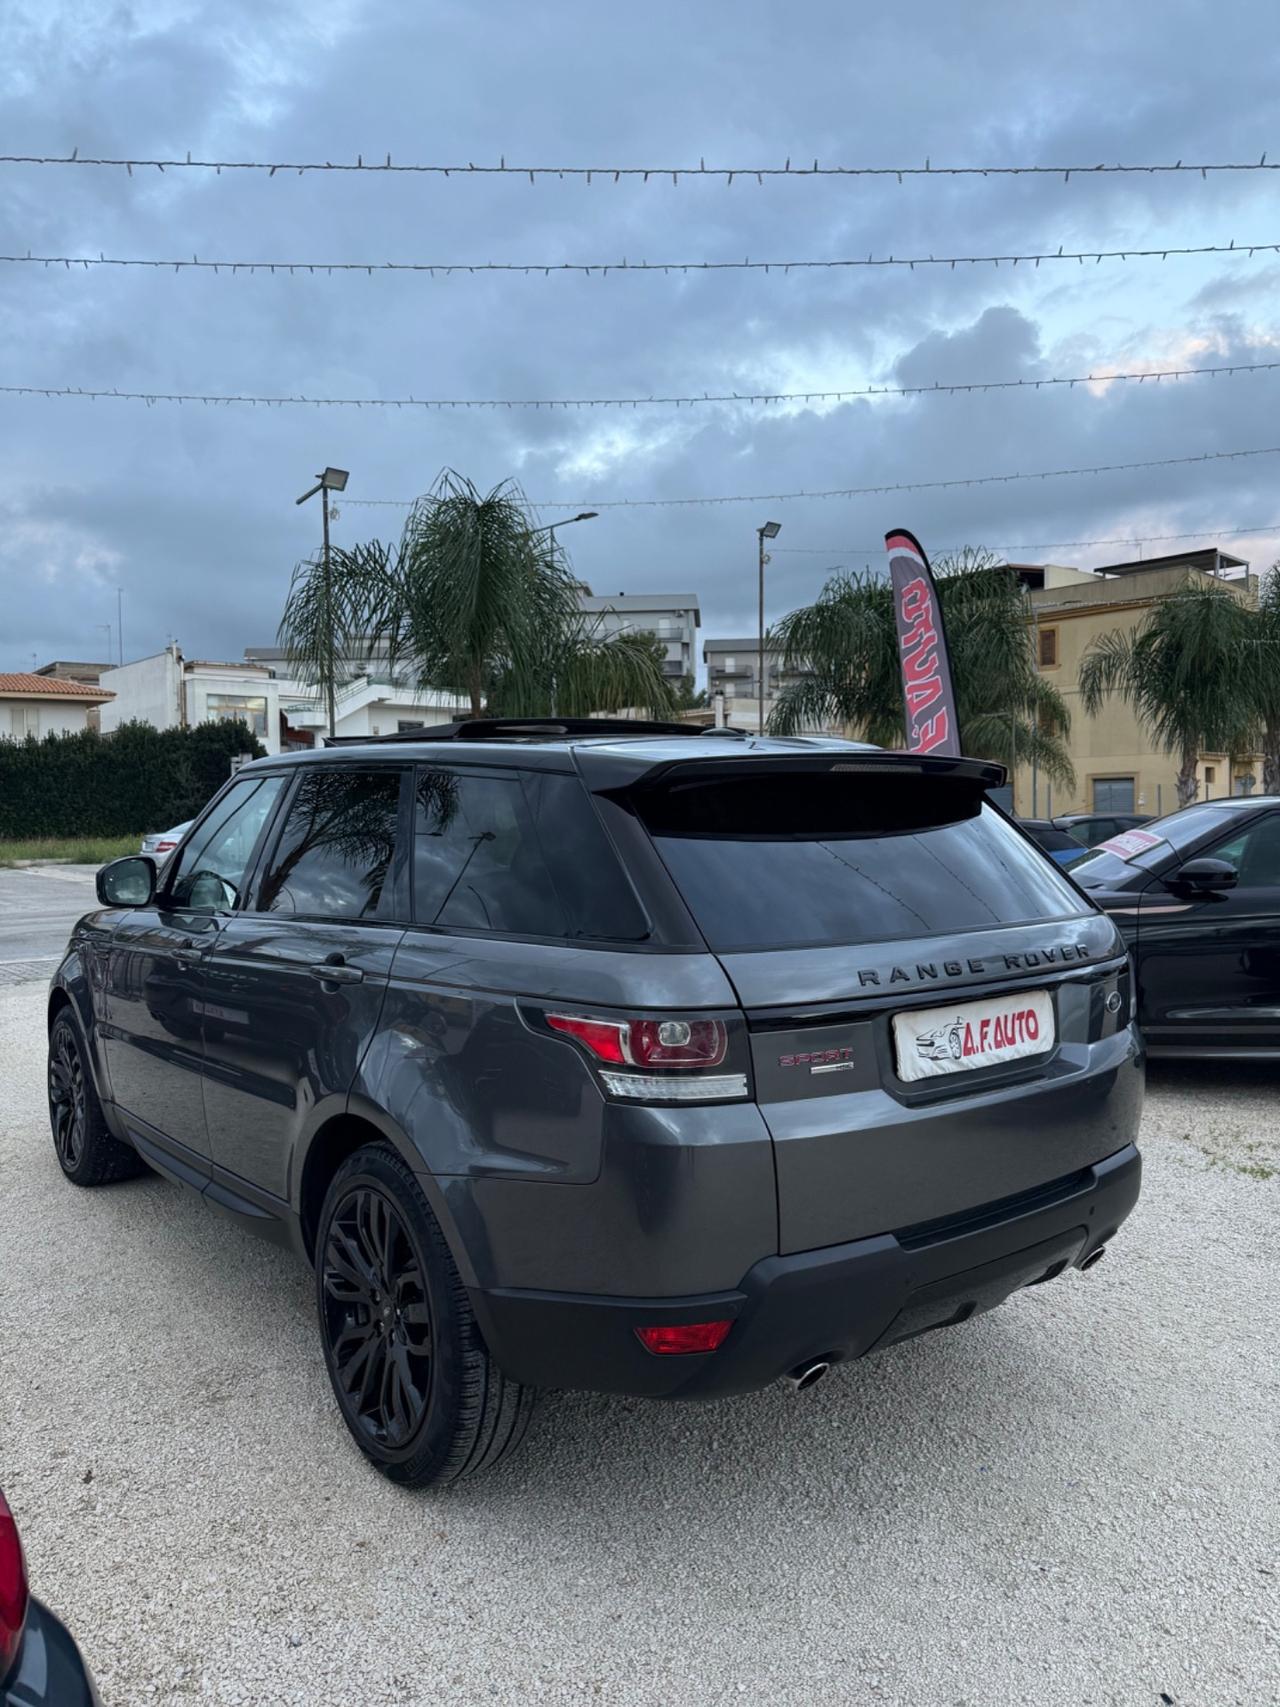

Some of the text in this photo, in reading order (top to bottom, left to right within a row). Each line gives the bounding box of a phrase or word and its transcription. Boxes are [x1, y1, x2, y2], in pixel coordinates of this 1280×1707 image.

[857, 943, 1090, 987] RANGE ROVER
[778, 1047, 854, 1067] SPORT
